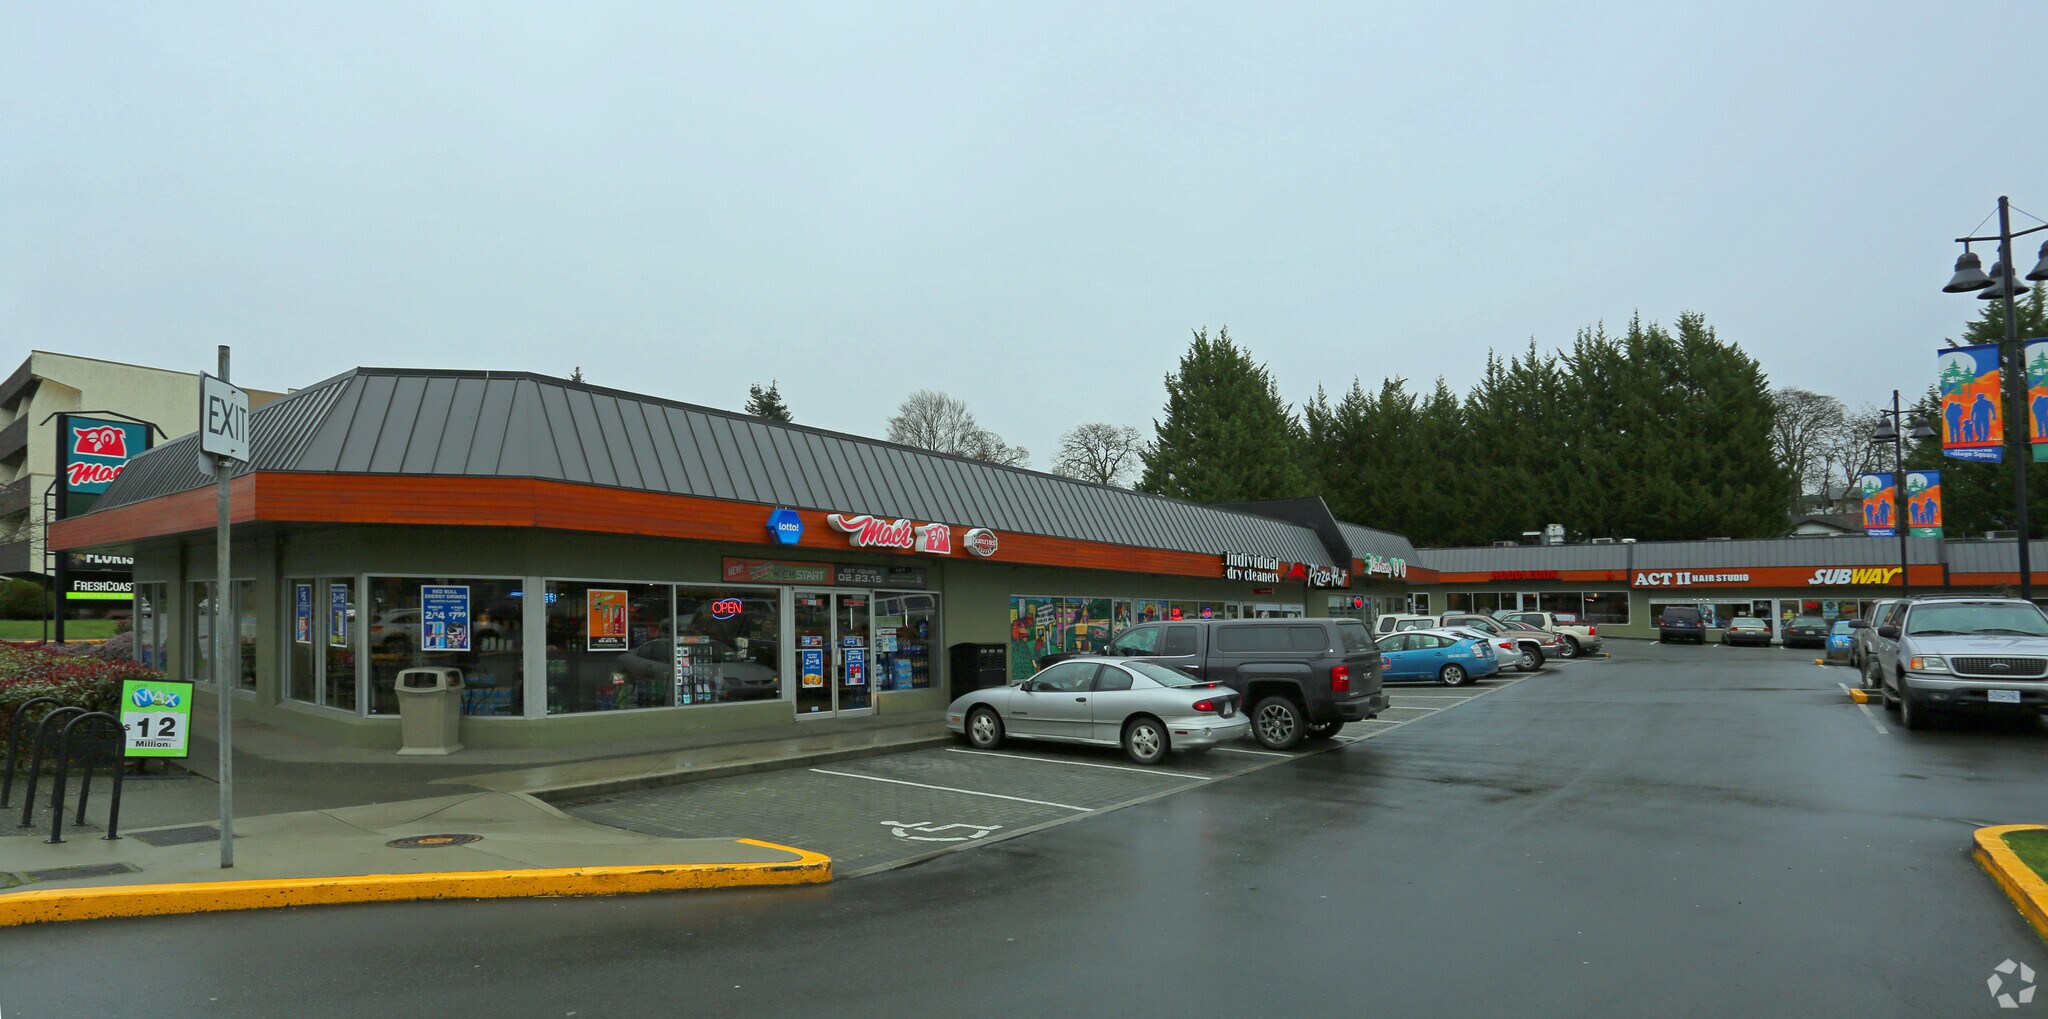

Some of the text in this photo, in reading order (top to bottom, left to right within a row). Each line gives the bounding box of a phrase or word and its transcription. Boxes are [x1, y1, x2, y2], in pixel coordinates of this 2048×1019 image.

[209, 395, 247, 443] EXIT
[779, 521, 799, 532] lotto!
[838, 515, 914, 549] Mac's
[1226, 551, 1279, 571] individual
[728, 563, 744, 577] NEW!
[774, 569, 825, 580] KICKSTART
[1227, 567, 1279, 583] dry cleaners
[1307, 563, 1347, 587] Pizza Hut
[1635, 572, 1749, 585] ACT II HAIR STUDIO
[1807, 567, 1903, 584] SUBWAY
[712, 601, 742, 614] OPEN
[132, 688, 178, 707] MAX
[137, 717, 176, 737] 12
